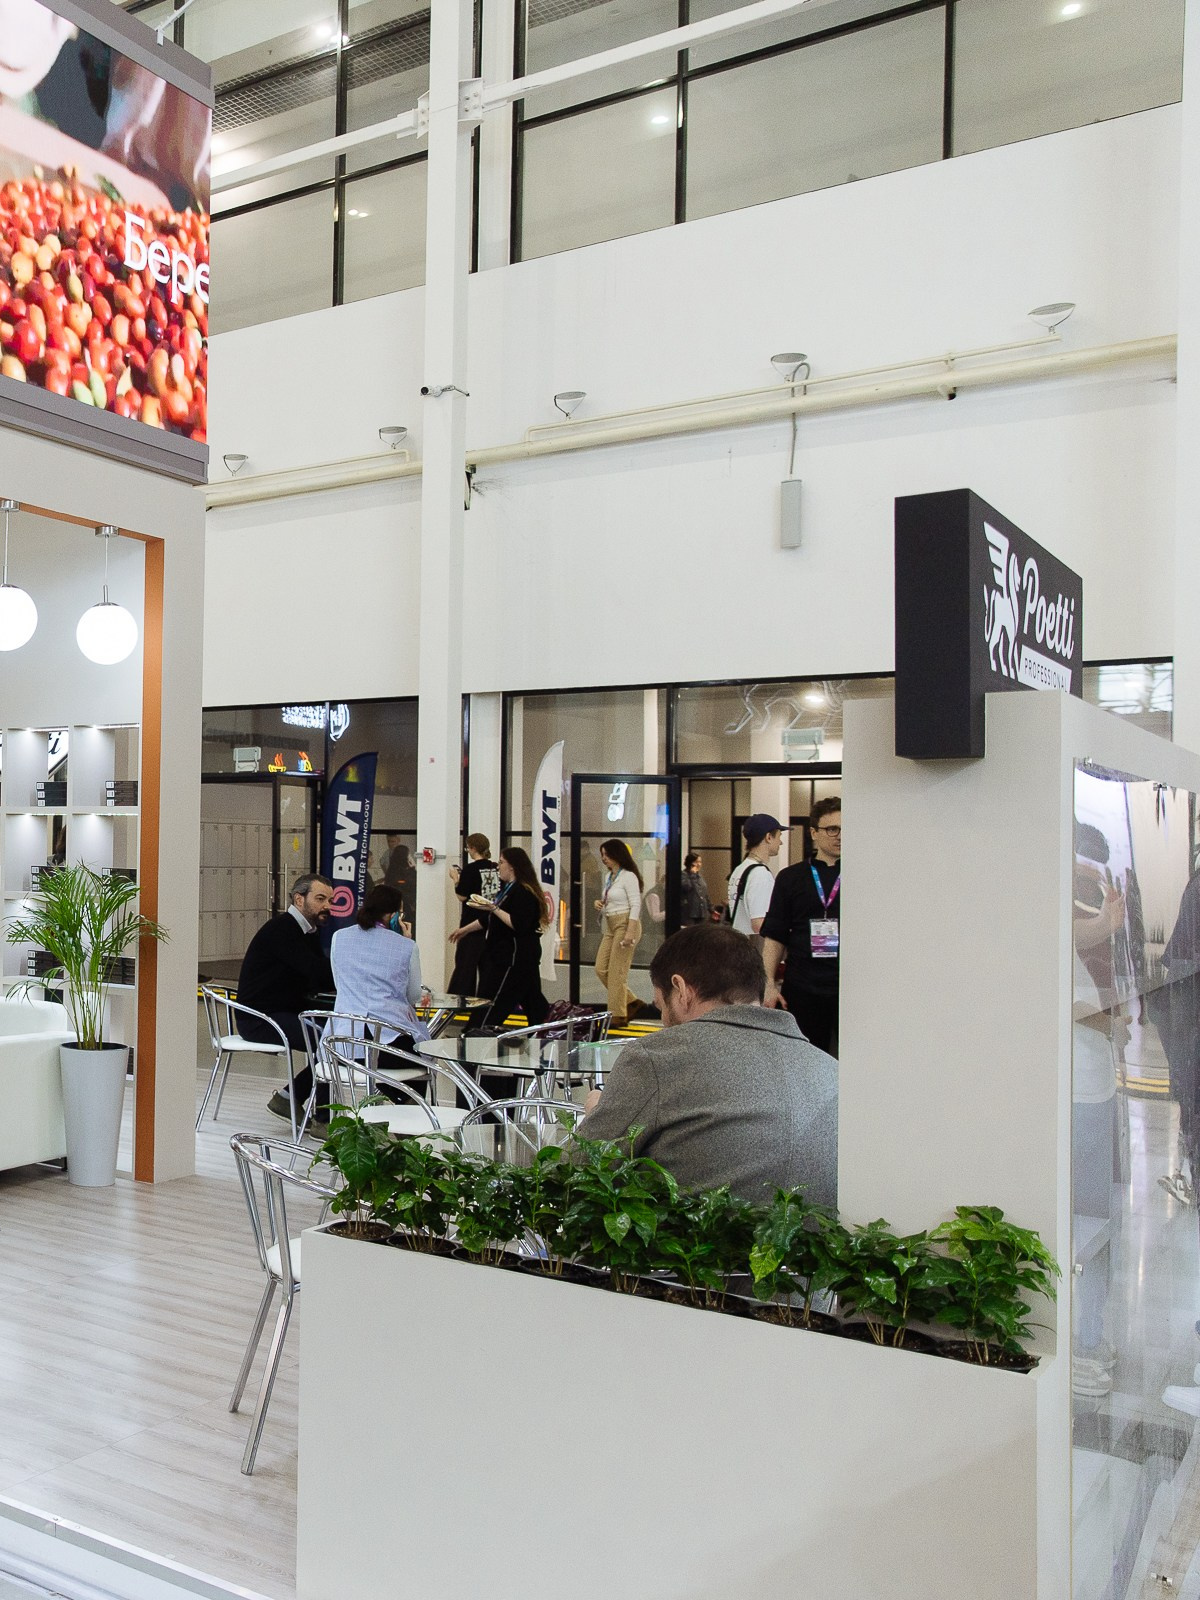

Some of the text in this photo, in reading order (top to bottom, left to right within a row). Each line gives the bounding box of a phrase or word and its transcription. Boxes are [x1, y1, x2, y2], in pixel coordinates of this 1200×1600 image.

[1022, 557, 1075, 660] Poetti
[1024, 657, 1068, 692] PROFESSIONAL
[332, 794, 362, 882] BWT
[361, 798, 371, 858] TECHNOLOGY
[541, 789, 557, 886] BWT
[358, 860, 367, 892] WATER
